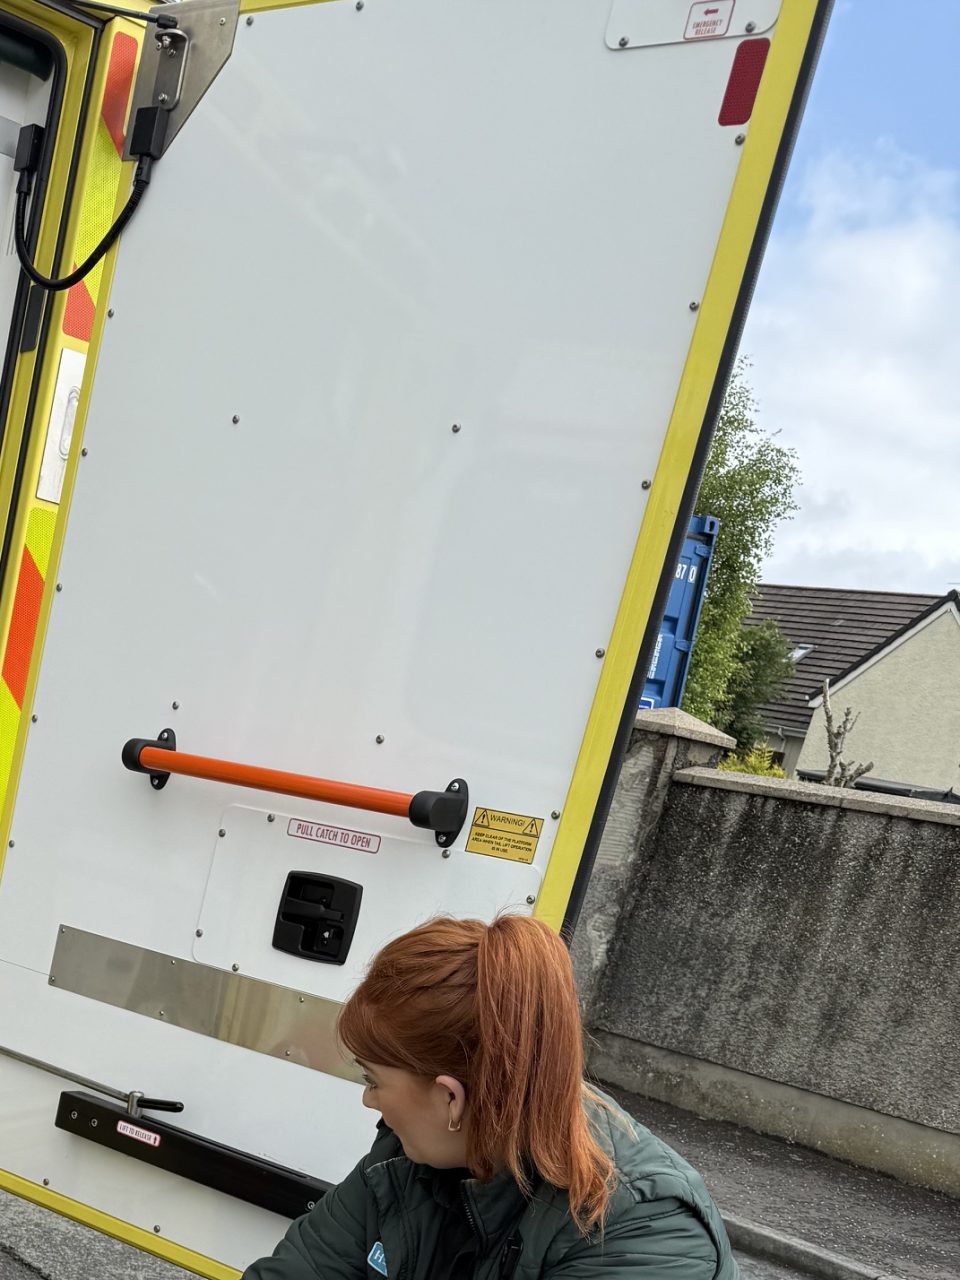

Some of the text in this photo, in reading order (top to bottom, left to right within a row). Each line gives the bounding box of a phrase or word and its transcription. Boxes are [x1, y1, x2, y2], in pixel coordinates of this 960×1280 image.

[693, 19, 723, 29] EMERGENCY
[695, 27, 716, 35] RELEASE
[490, 814, 525, 827] WARNING!
[296, 823, 371, 848] PULL CATCH TO OPEN
[119, 1123, 151, 1141] LIFT TO RELEASE
